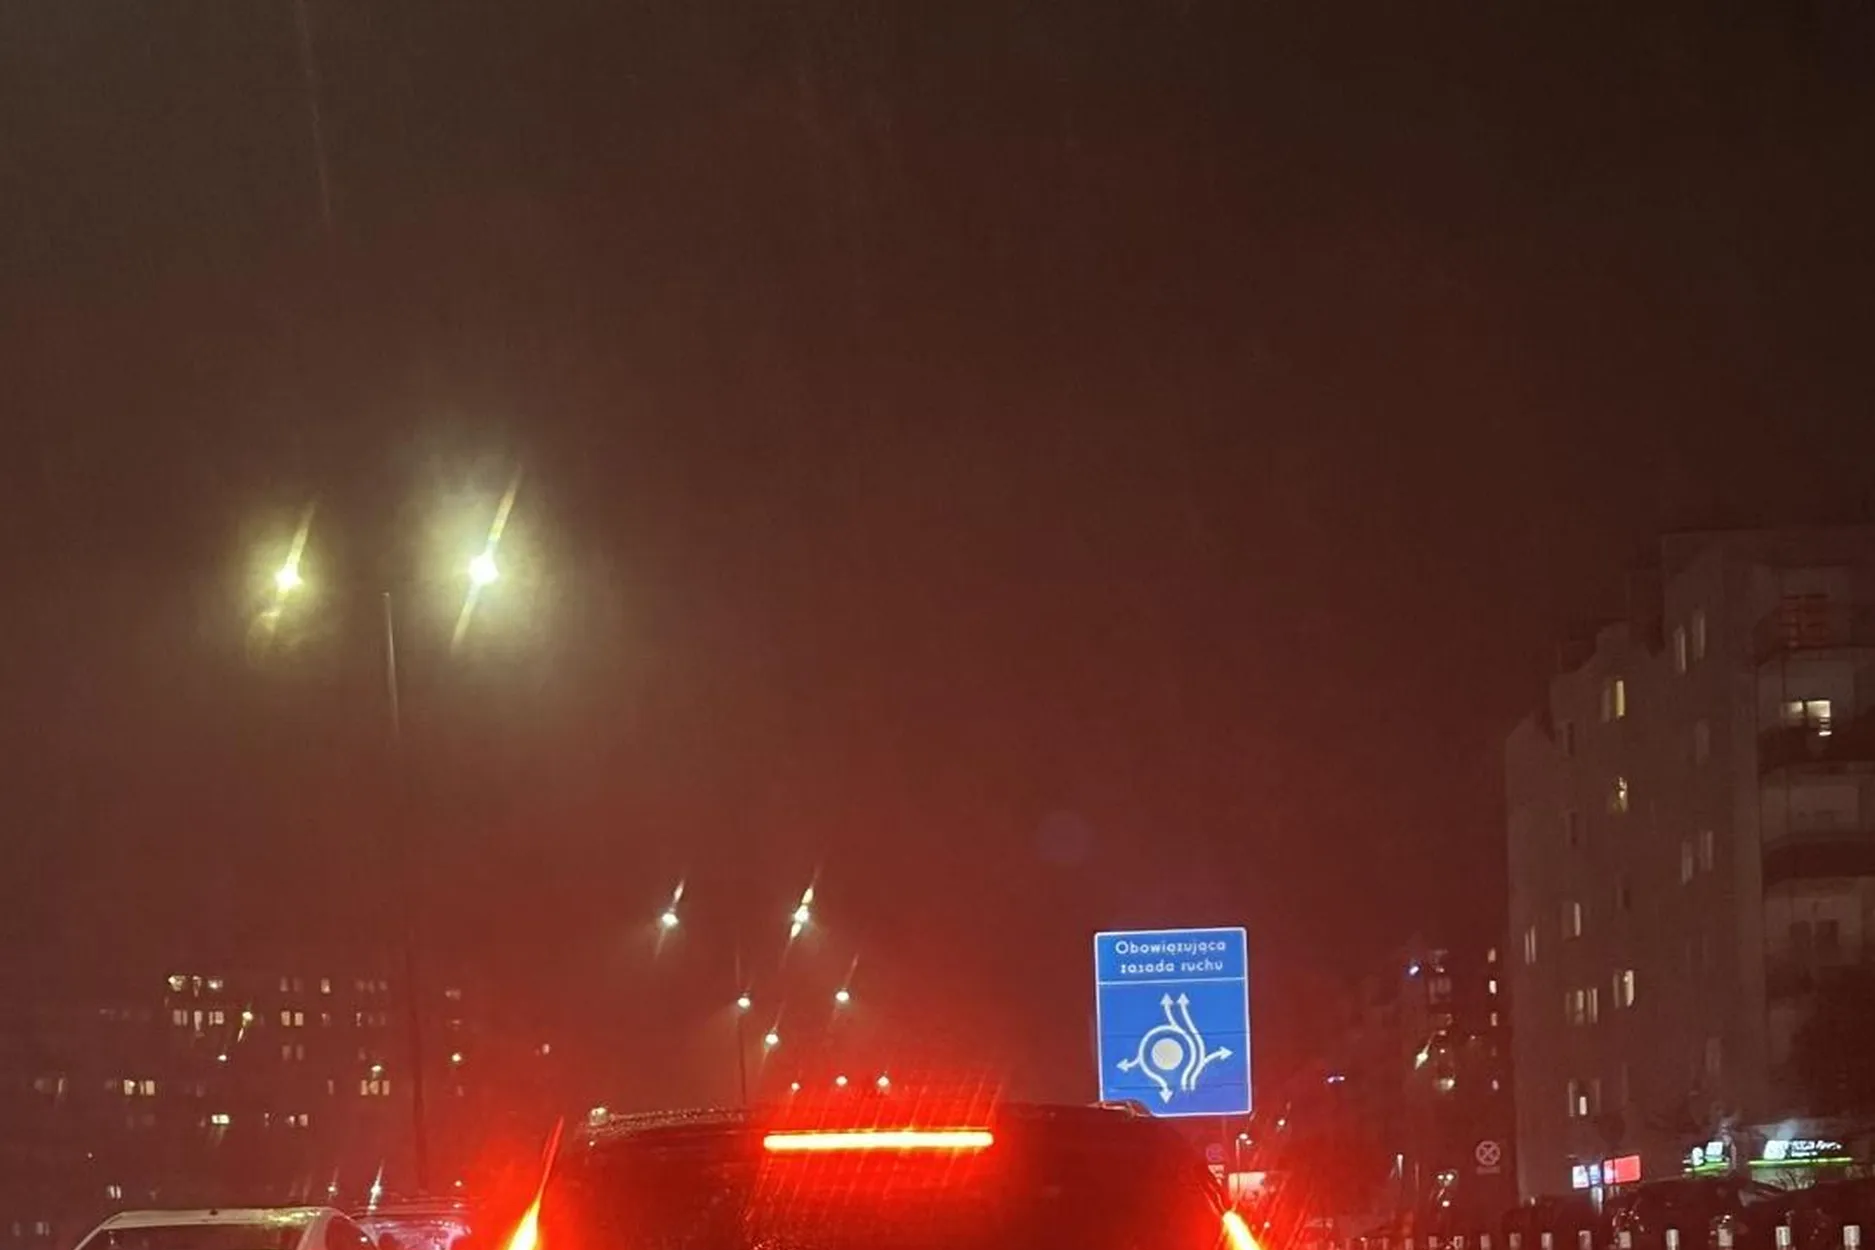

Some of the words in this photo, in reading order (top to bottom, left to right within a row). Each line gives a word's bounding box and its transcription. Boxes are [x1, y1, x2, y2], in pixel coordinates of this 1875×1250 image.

[1115, 941, 1226, 955] Obowiązująca
[1121, 960, 1175, 974] zasada
[1181, 958, 1223, 971] ruchu
